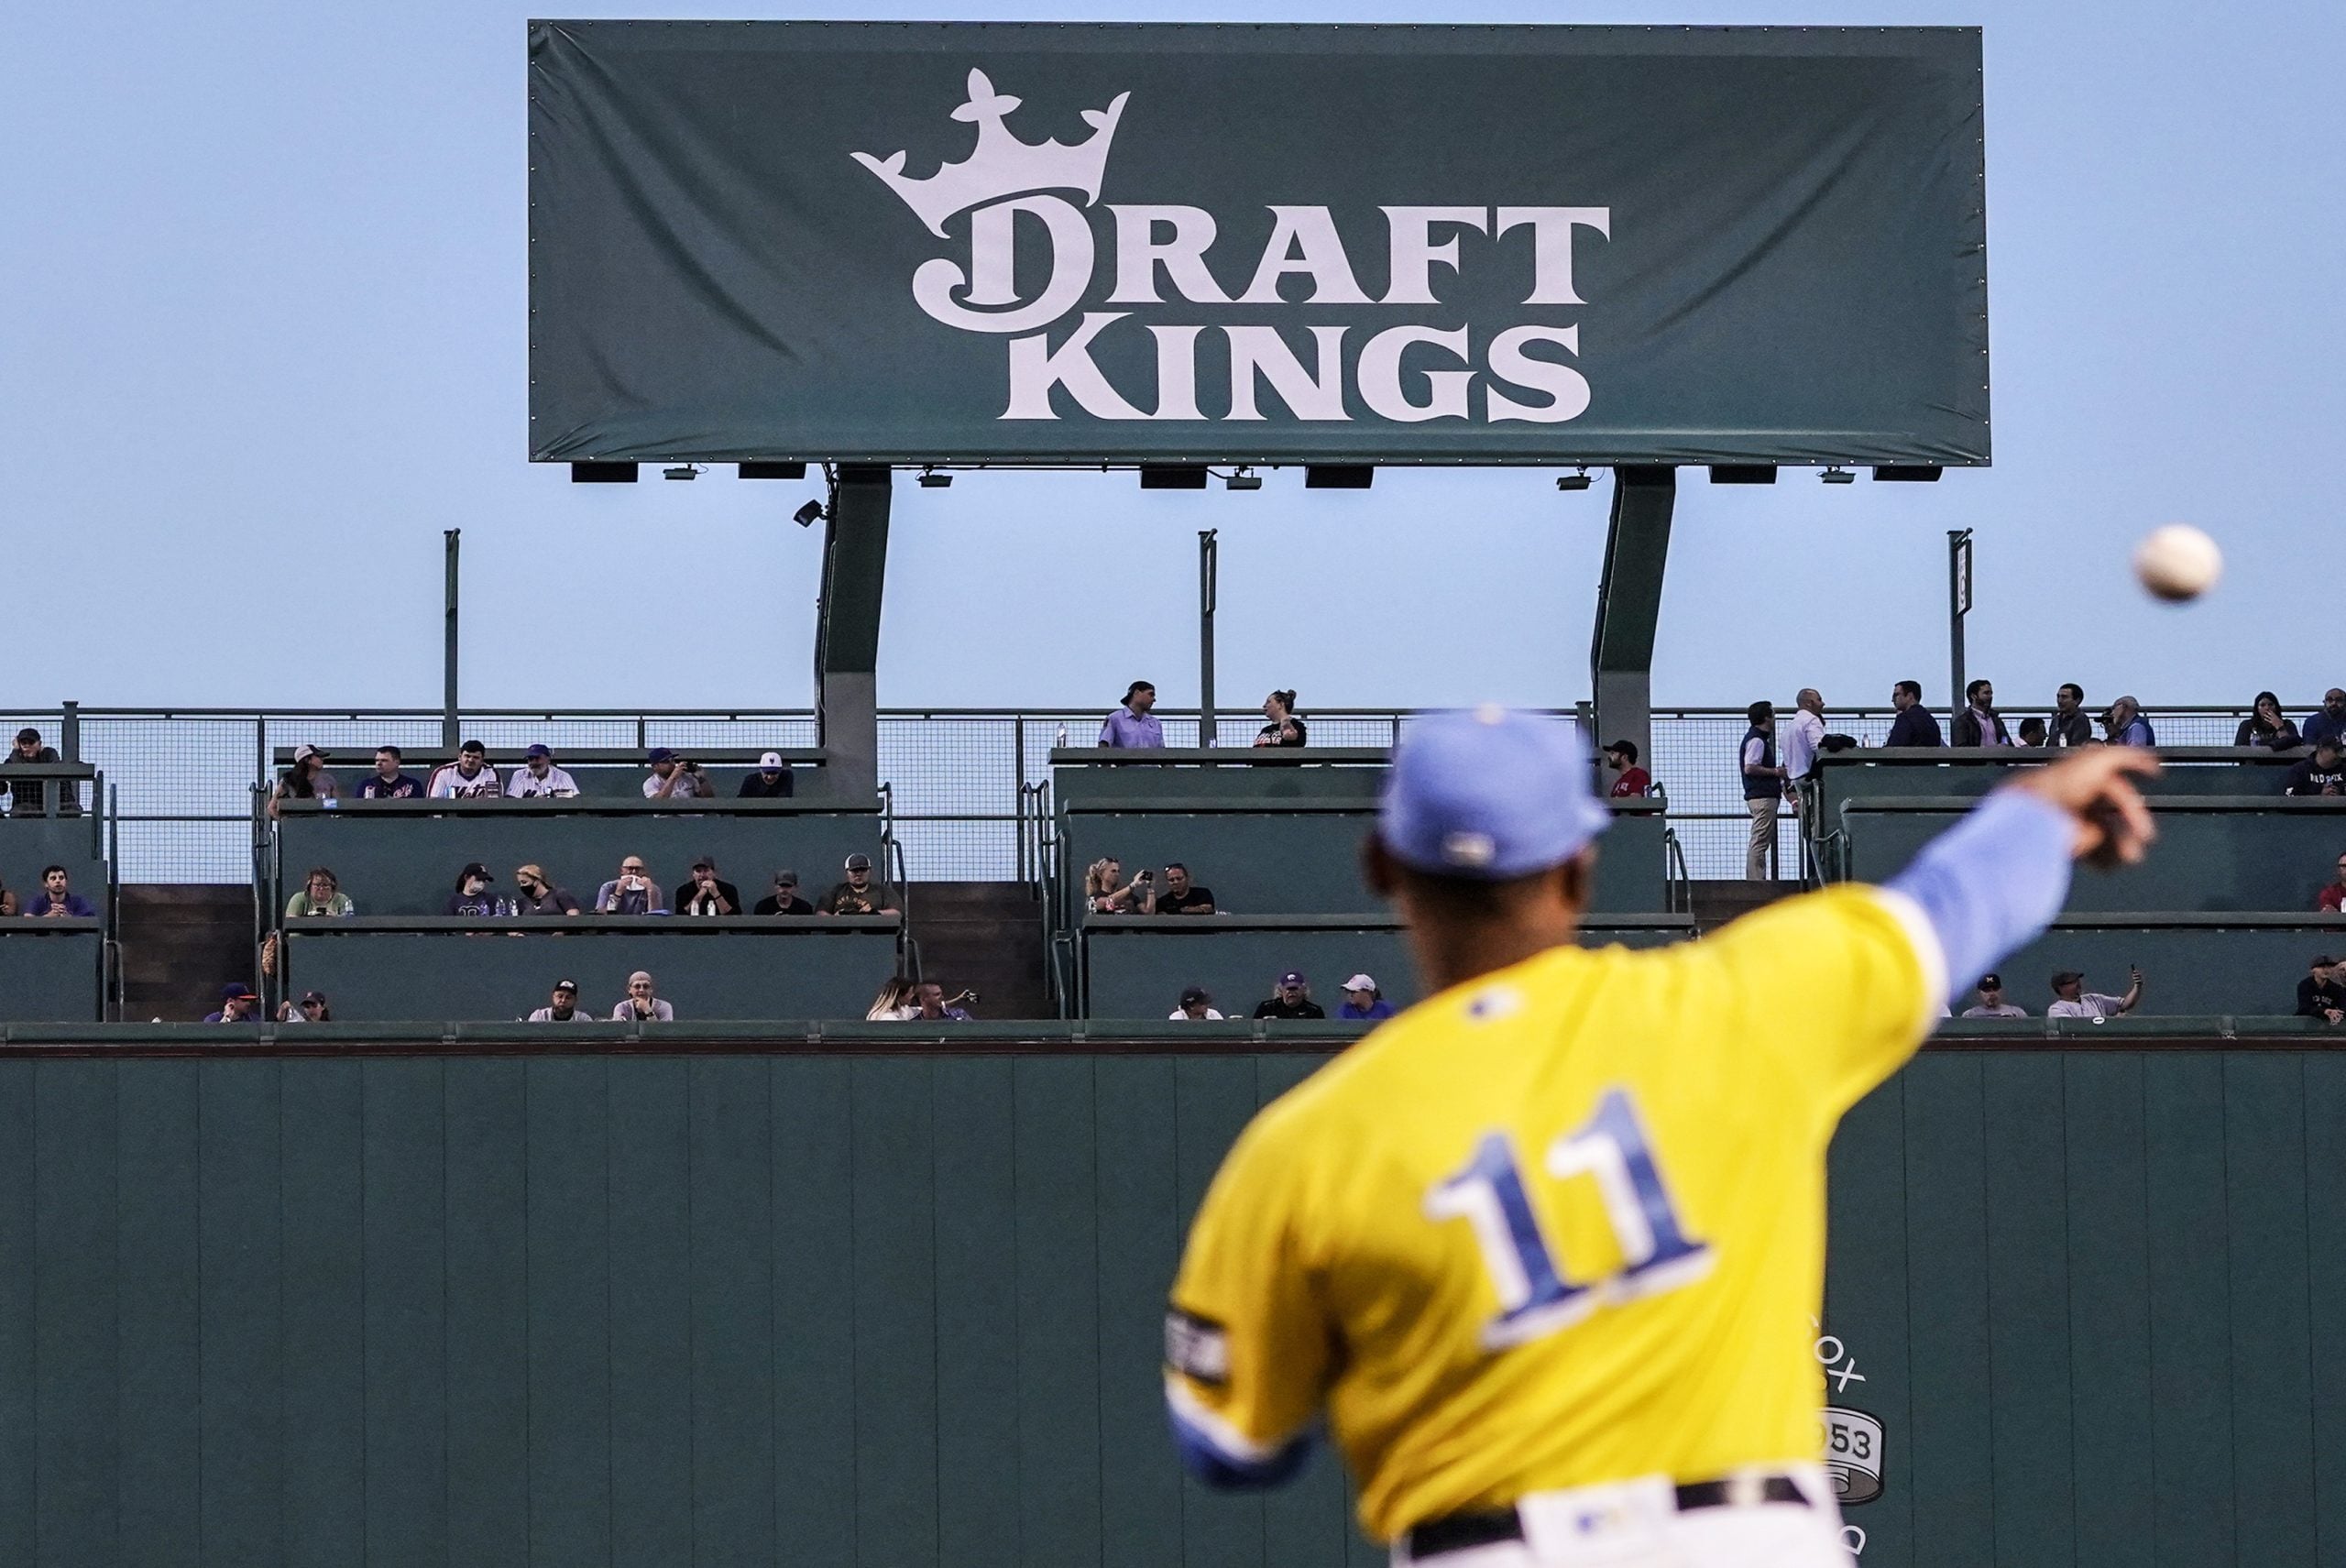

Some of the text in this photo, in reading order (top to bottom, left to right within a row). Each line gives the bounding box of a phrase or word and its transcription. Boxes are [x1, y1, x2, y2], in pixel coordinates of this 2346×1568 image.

[912, 194, 1610, 334] DRAFT
[996, 312, 1591, 422] KINGS
[1424, 1087, 1716, 1351] 11
[1809, 1314, 1866, 1394] OX
